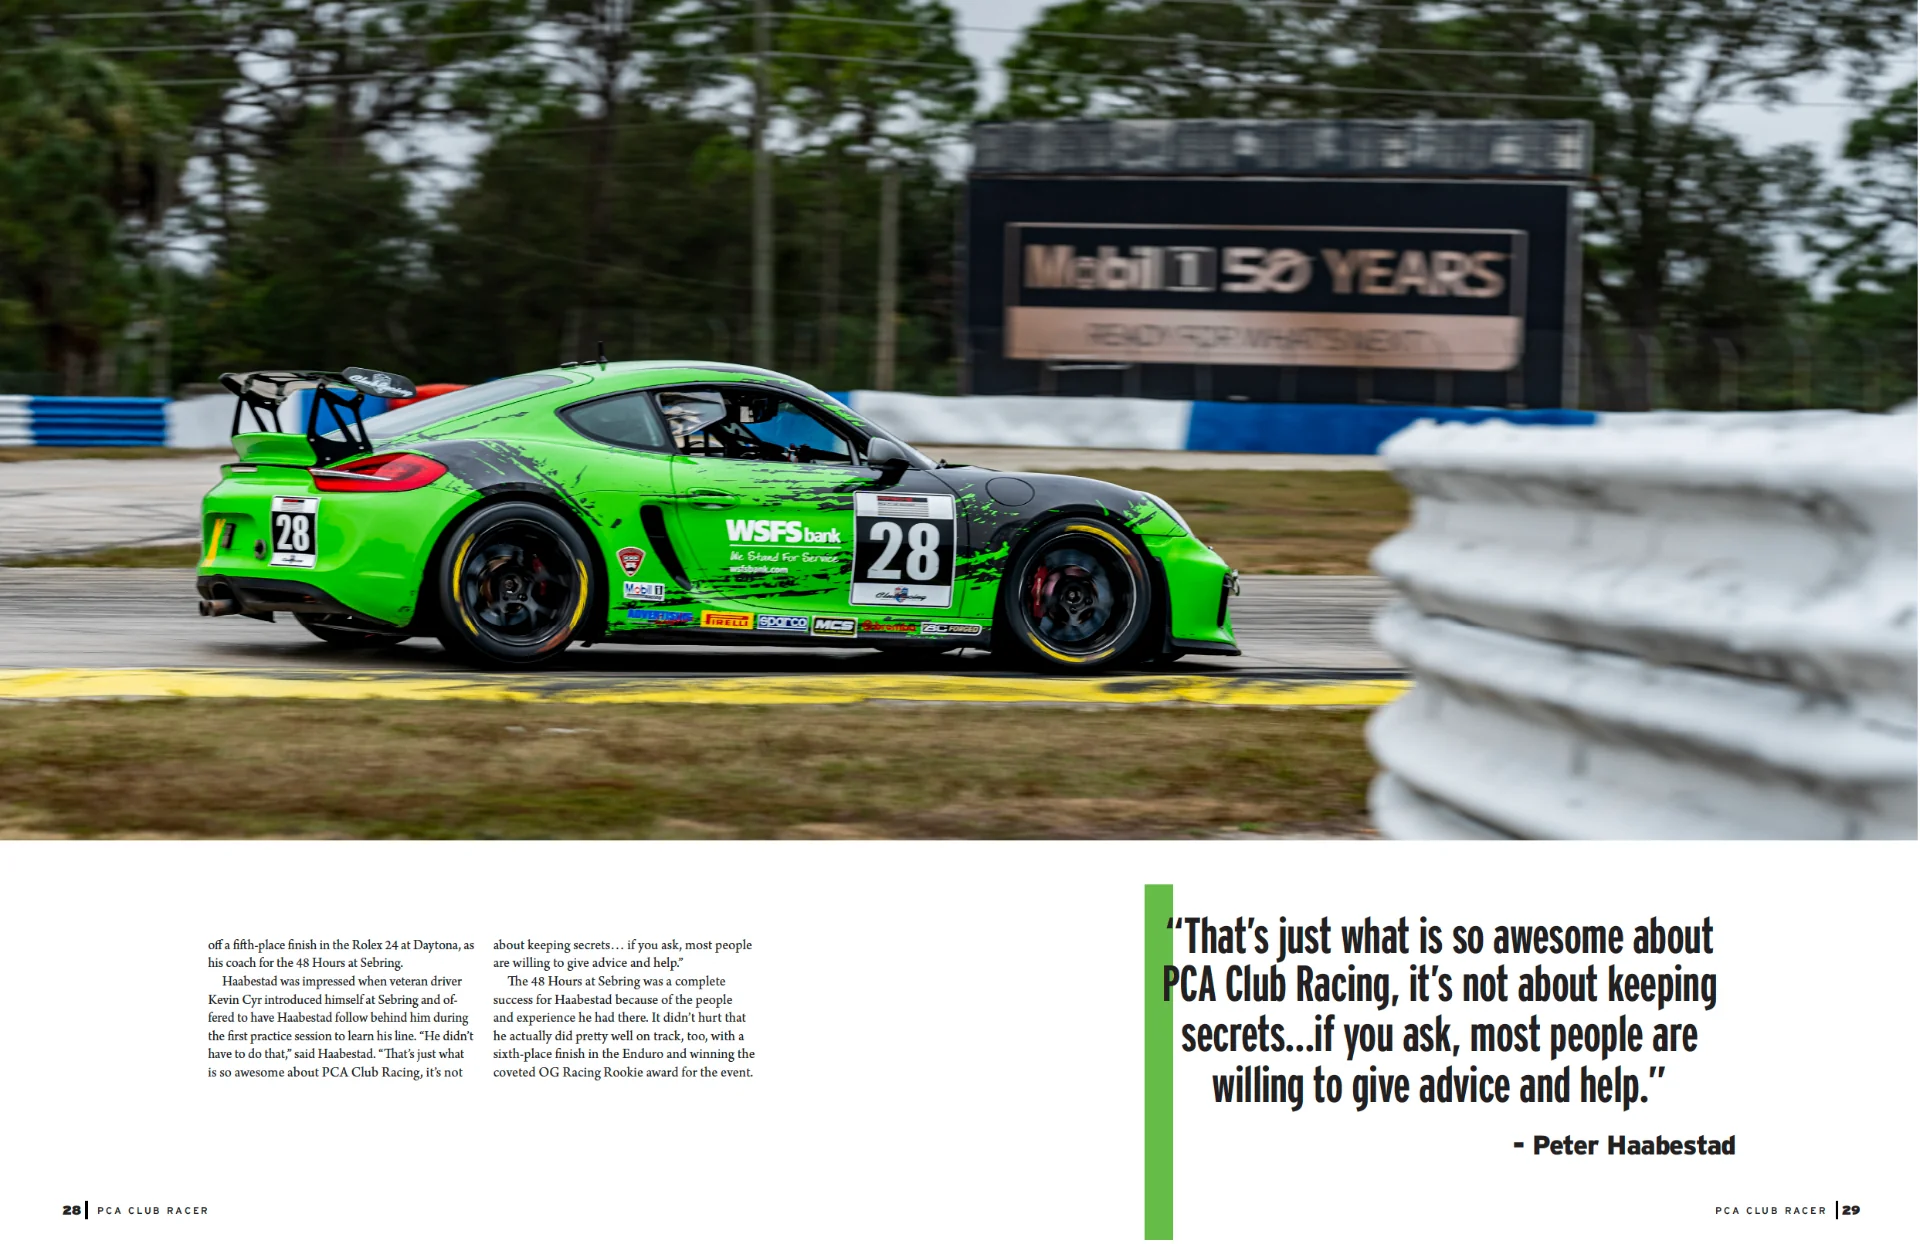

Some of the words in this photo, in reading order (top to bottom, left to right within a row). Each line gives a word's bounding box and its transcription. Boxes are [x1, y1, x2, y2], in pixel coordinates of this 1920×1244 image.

[1025, 244, 1163, 290] Mobil
[1222, 246, 1312, 293] 50
[1321, 249, 1506, 297] YEARS
[275, 513, 310, 552] 28
[725, 519, 803, 543] WSFS
[803, 527, 841, 543] bank
[747, 551, 779, 562] Stand
[782, 552, 800, 562] For
[802, 553, 839, 563] Service
[866, 521, 940, 581] 28
[729, 565, 788, 574] wsfsbank.com
[625, 583, 653, 595] Mobil
[706, 614, 749, 626] PIRELLI
[759, 616, 807, 626] sparco
[815, 619, 854, 631] MCS
[948, 625, 980, 633] FORGED
[207, 938, 224, 950] off
[224, 942, 231, 950] a
[232, 938, 286, 954] fifth-place
[287, 938, 318, 950] finish
[319, 939, 331, 950] in
[332, 938, 350, 950] the
[351, 938, 383, 950] Rolex
[384, 940, 400, 951] 24
[400, 940, 412, 950] at
[413, 939, 462, 954] Daytona,
[463, 942, 475, 950] as
[1166, 916, 1269, 954] “That’s
[1276, 916, 1331, 963] just
[1341, 916, 1409, 954] what
[1420, 916, 1443, 954] is
[1453, 925, 1484, 954] so
[1494, 925, 1624, 954] awesome
[1633, 916, 1714, 954] about
[207, 956, 224, 968] his
[225, 956, 257, 968] coach
[258, 956, 275, 968] for
[276, 956, 294, 968] the
[295, 957, 310, 969] 48
[311, 957, 346, 968] Hours
[347, 958, 358, 968] at
[360, 956, 404, 972] Sebring.
[493, 960, 510, 968] are
[512, 956, 551, 972] willing
[553, 958, 565, 968] to
[566, 957, 590, 972] give
[591, 956, 628, 968] advice
[630, 956, 651, 968] and
[653, 956, 684, 972] help.”
[222, 974, 278, 987] Haabestad
[279, 978, 301, 987] was
[302, 975, 356, 990] impressed
[357, 975, 387, 987] when
[388, 977, 429, 987] veteran
[430, 975, 463, 987] driver
[507, 974, 529, 987] The
[530, 976, 546, 987] 48
[547, 975, 583, 987] Hours
[585, 977, 596, 987] at
[597, 975, 641, 990] Sebring
[642, 978, 664, 987] was
[665, 978, 673, 987] a
[674, 974, 726, 990] complete
[1163, 964, 1216, 1002] PCA
[1226, 964, 1286, 1002] Club
[1297, 964, 1399, 1011] Racing,
[1410, 964, 1453, 1002] it’s
[1463, 964, 1508, 1002] not
[1518, 964, 1598, 1002] about
[1609, 964, 1717, 1011] keeping
[208, 994, 240, 1005] Kevin
[241, 994, 263, 1009] Cyr
[264, 993, 323, 1005] introduced
[324, 993, 365, 1005] himself
[365, 995, 376, 1005] at
[377, 993, 420, 1009] Sebring
[420, 993, 441, 1005] and
[442, 993, 458, 1005] of-
[493, 1011, 514, 1023] and
[516, 1012, 576, 1027] experience
[578, 1011, 592, 1023] he
[594, 1011, 615, 1023] had
[617, 1011, 649, 1023] there.
[651, 1011, 661, 1023] It
[662, 1011, 696, 1023] didn’t
[697, 1011, 722, 1023] hurt
[725, 1011, 747, 1023] that
[492, 1029, 507, 1041] he
[509, 1029, 553, 1045] actually
[554, 1029, 573, 1041] did
[575, 1031, 609, 1045] pretty
[610, 1029, 634, 1041] well
[635, 1033, 651, 1041] on
[653, 1029, 685, 1044] track,
[686, 1031, 708, 1044] too,
[710, 1029, 736, 1041] with
[738, 1033, 745, 1041] a
[1182, 1014, 1335, 1052] secrets...if
[1343, 1023, 1393, 1061] you
[1403, 1014, 1460, 1057] ask,
[1471, 1014, 1541, 1052] most
[1551, 1014, 1643, 1061] people
[1653, 1023, 1698, 1052] are
[207, 1047, 233, 1059] have
[234, 1049, 246, 1059] to
[247, 1047, 263, 1059] do
[264, 1047, 293, 1061] that,”
[294, 1047, 316, 1059] said
[317, 1047, 376, 1059] Haabestad.
[378, 1047, 415, 1059] “That’s
[416, 1048, 437, 1063] just
[438, 1047, 465, 1059] what
[493, 1066, 536, 1078] coveted
[538, 1066, 560, 1078] OG
[562, 1066, 602, 1082] Racing
[603, 1065, 644, 1078] Rookie
[646, 1066, 679, 1078] award
[681, 1065, 698, 1078] for
[700, 1065, 718, 1078] the
[720, 1068, 754, 1078] event.
[1212, 1065, 1304, 1112] willing
[1313, 1065, 1342, 1103] to
[1352, 1065, 1410, 1112] give
[1419, 1065, 1510, 1103] advice
[1520, 1065, 1570, 1103] and
[1581, 1065, 1665, 1112] help.”
[1533, 1134, 1600, 1156] Peter
[1607, 1134, 1736, 1156] Haabestad
[62, 1205, 82, 1216] 28
[97, 1206, 122, 1215] PCA
[128, 1206, 160, 1215] CLUB
[167, 1206, 208, 1215] RACER
[1715, 1206, 1740, 1215] PCA
[1746, 1206, 1778, 1215] CLUB
[1785, 1206, 1826, 1215] RACER
[1841, 1205, 1861, 1216] 29
